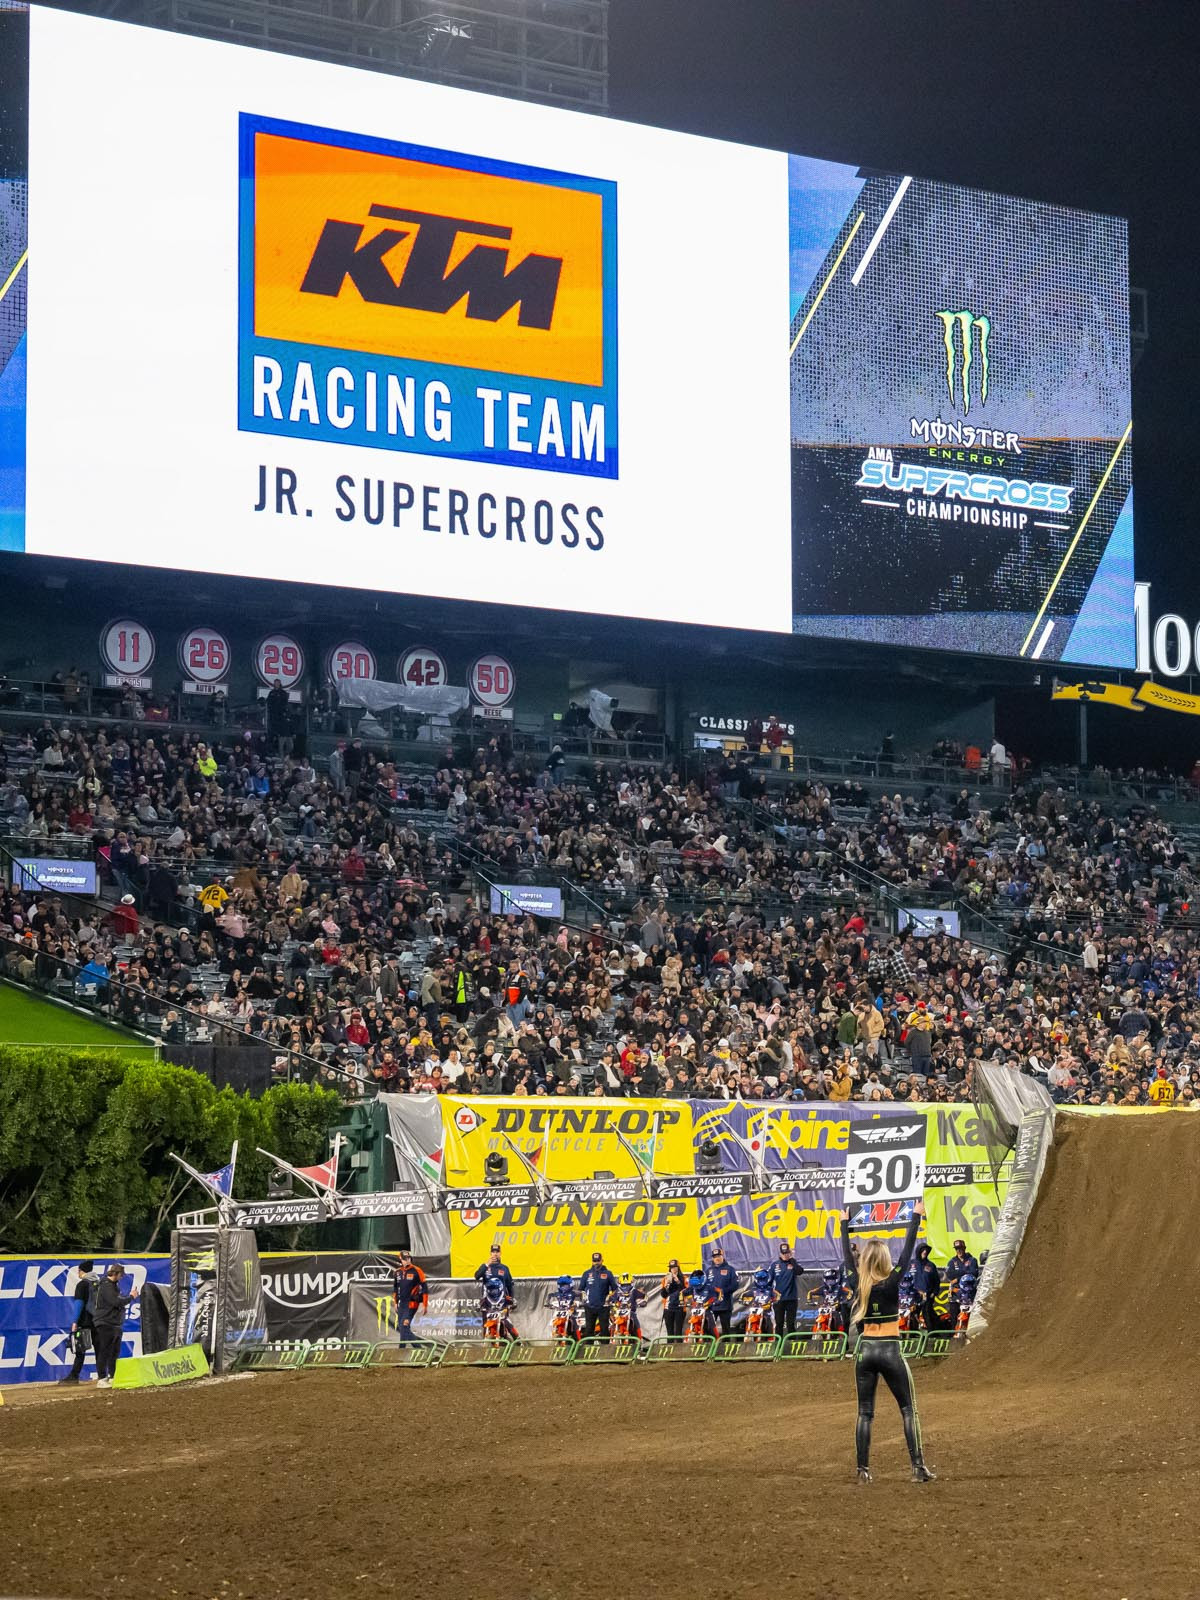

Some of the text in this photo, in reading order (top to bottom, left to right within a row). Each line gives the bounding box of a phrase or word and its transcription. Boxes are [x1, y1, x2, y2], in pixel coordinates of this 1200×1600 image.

[300, 203, 563, 331] KTM
[254, 355, 605, 463] RACING TEAM
[868, 447, 894, 461] AMA
[929, 448, 1005, 466] ENERGY
[857, 459, 1075, 513] SUPERCROSS
[254, 465, 604, 551] JR. SUPERCROSS
[907, 499, 1028, 529] CHAMPIONSHIP
[119, 631, 139, 662] 11
[190, 638, 224, 669] 26
[264, 645, 298, 676] 29
[337, 652, 369, 679] 30
[407, 659, 439, 686] 42
[478, 664, 509, 694] 50
[700, 716, 751, 732] CLASSI
[491, 1108, 680, 1133] DUNLOP
[853, 1124, 924, 1141] FLY
[564, 1182, 636, 1193] ROCKY MOUNTAIN
[670, 1176, 743, 1187] ROCKY MOUNTAIN
[783, 1172, 809, 1181] ROCKY
[857, 1154, 912, 1196] 30
[354, 1195, 425, 1206] ROCKY MOUNTAIN
[458, 1188, 530, 1199] ROCKY MOUNTAIN
[250, 1204, 319, 1215] ROCKY MOUNTAIN
[496, 1202, 686, 1227] DUNLOP
[848, 1200, 916, 1226] AMA
[492, 1230, 672, 1246] MOTORCYCLE TIRES
[422, 1328, 482, 1337] CHAMPIONSHIP
[153, 1353, 196, 1379] Kawasaki
